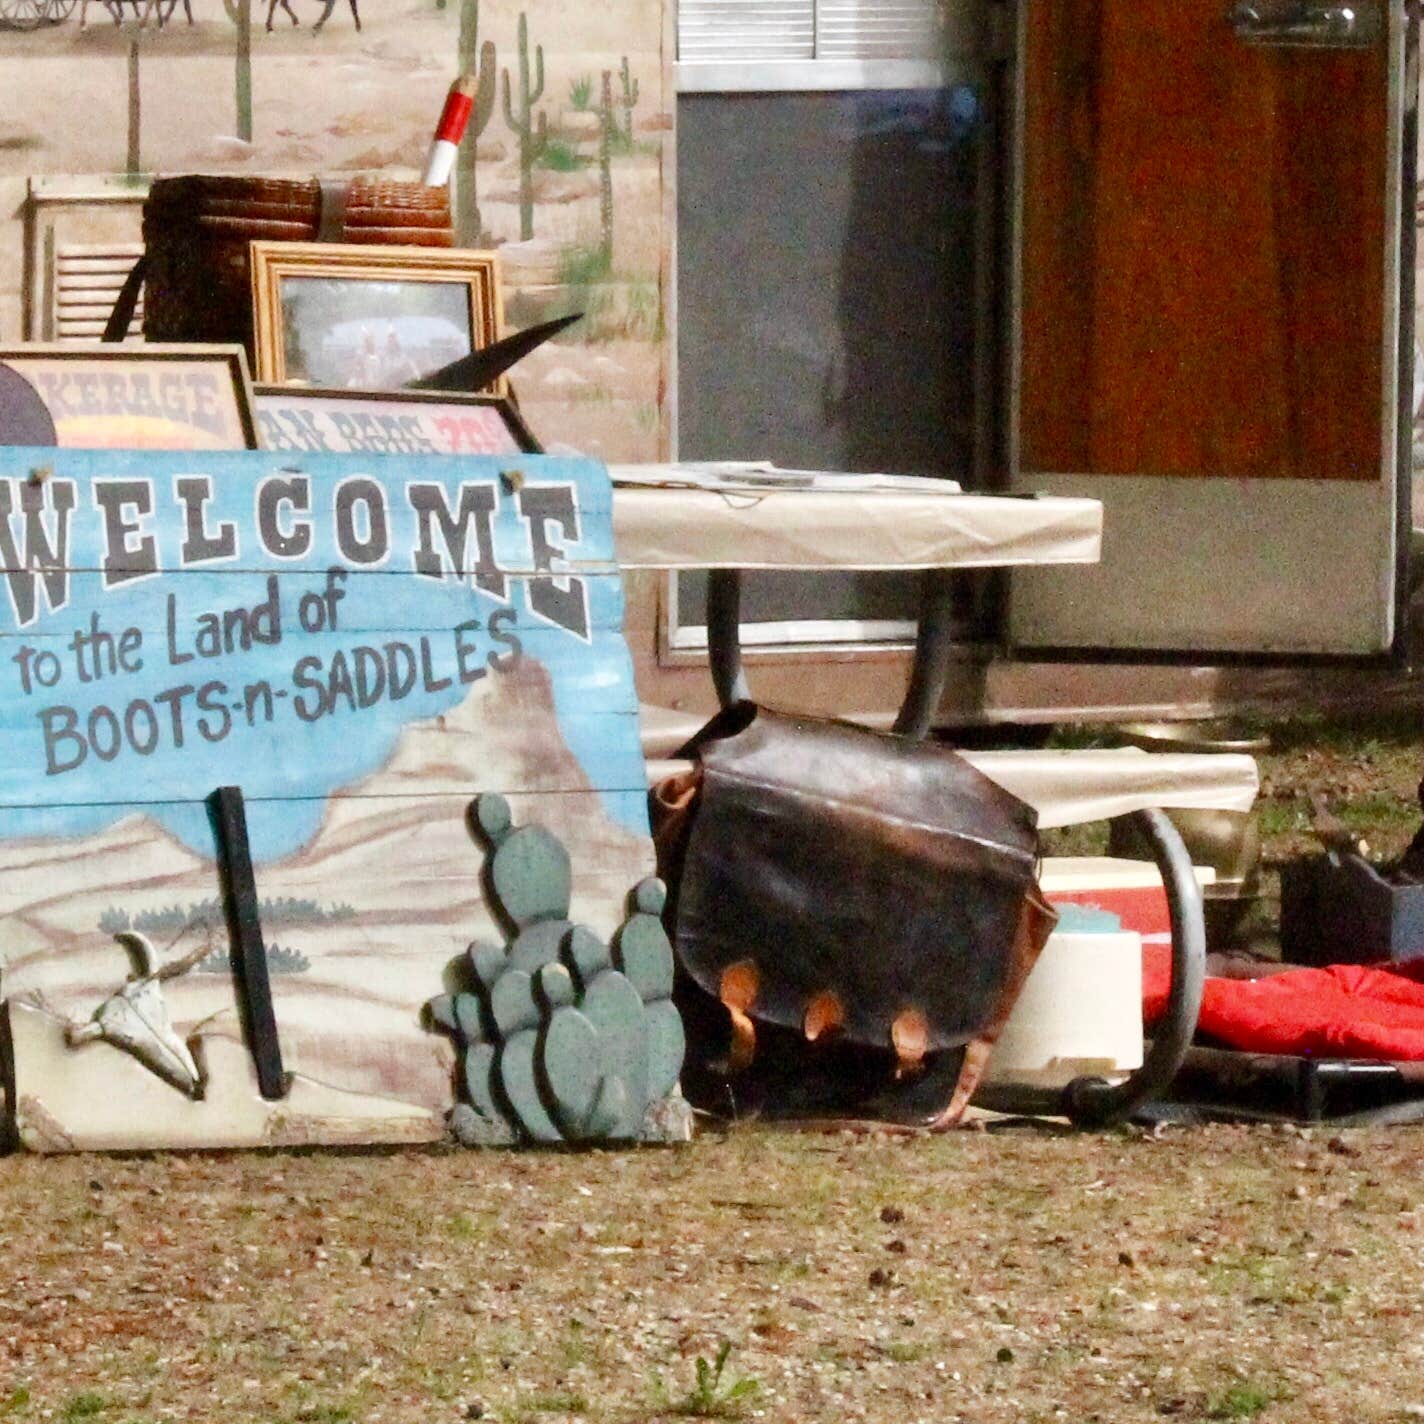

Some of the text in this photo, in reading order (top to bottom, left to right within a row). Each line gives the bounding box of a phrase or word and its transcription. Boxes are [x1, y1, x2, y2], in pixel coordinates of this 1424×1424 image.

[12, 565, 347, 694] to the Land of
